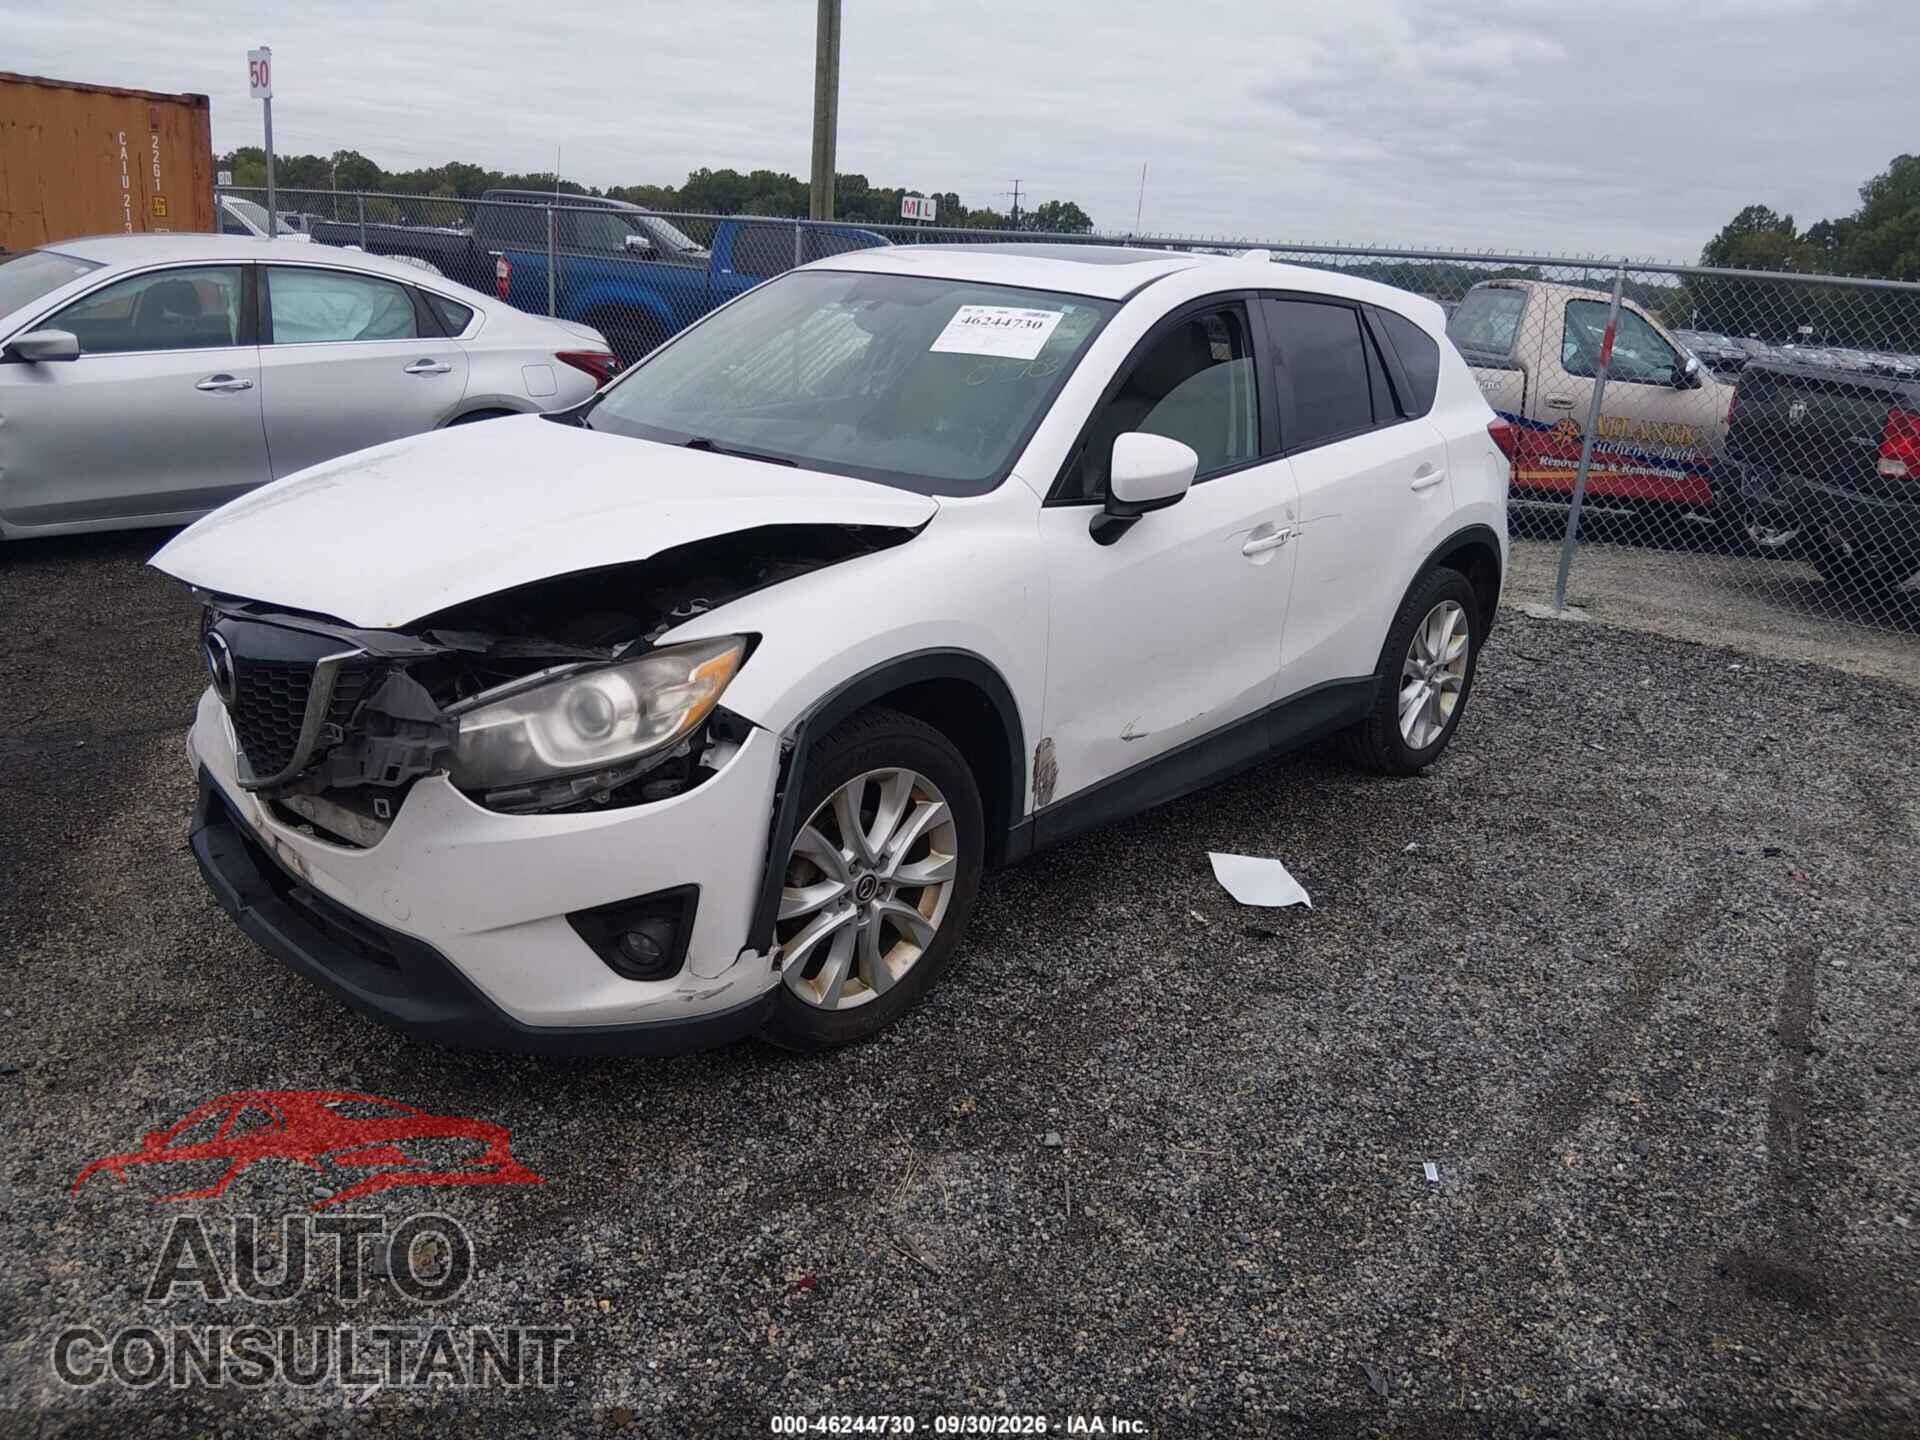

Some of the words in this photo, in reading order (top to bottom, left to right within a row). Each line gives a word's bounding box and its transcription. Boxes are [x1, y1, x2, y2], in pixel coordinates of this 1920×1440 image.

[250, 60, 269, 88] 50
[118, 131, 130, 189] CAIU
[151, 135, 161, 192] 22G1
[961, 315, 1044, 330] 46244730
[1592, 440, 1644, 457] itchen
[1608, 463, 1618, 473] &
[1621, 464, 1687, 481] Remodeling
